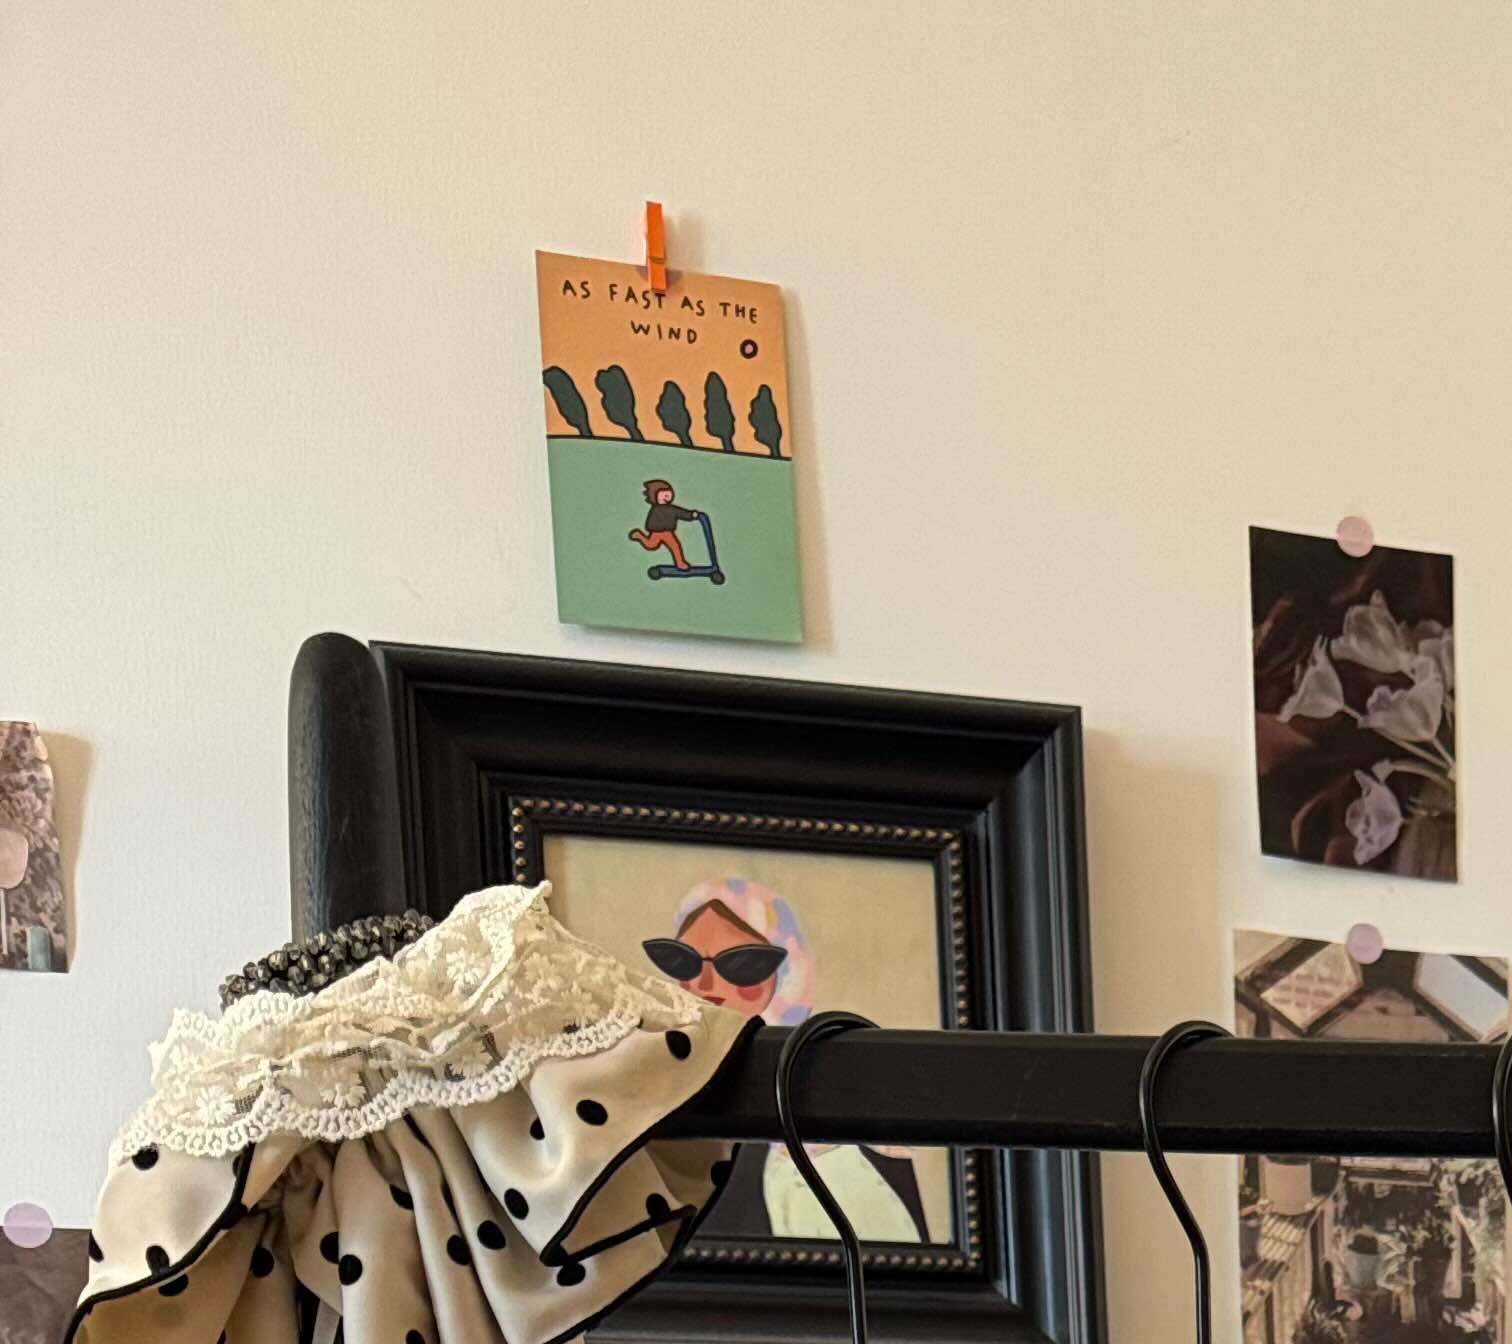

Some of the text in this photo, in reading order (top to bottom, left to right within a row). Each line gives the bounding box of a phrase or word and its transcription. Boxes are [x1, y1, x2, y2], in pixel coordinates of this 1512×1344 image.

[562, 280, 758, 324] AS FAST AS THE
[630, 320, 698, 345] WIND
